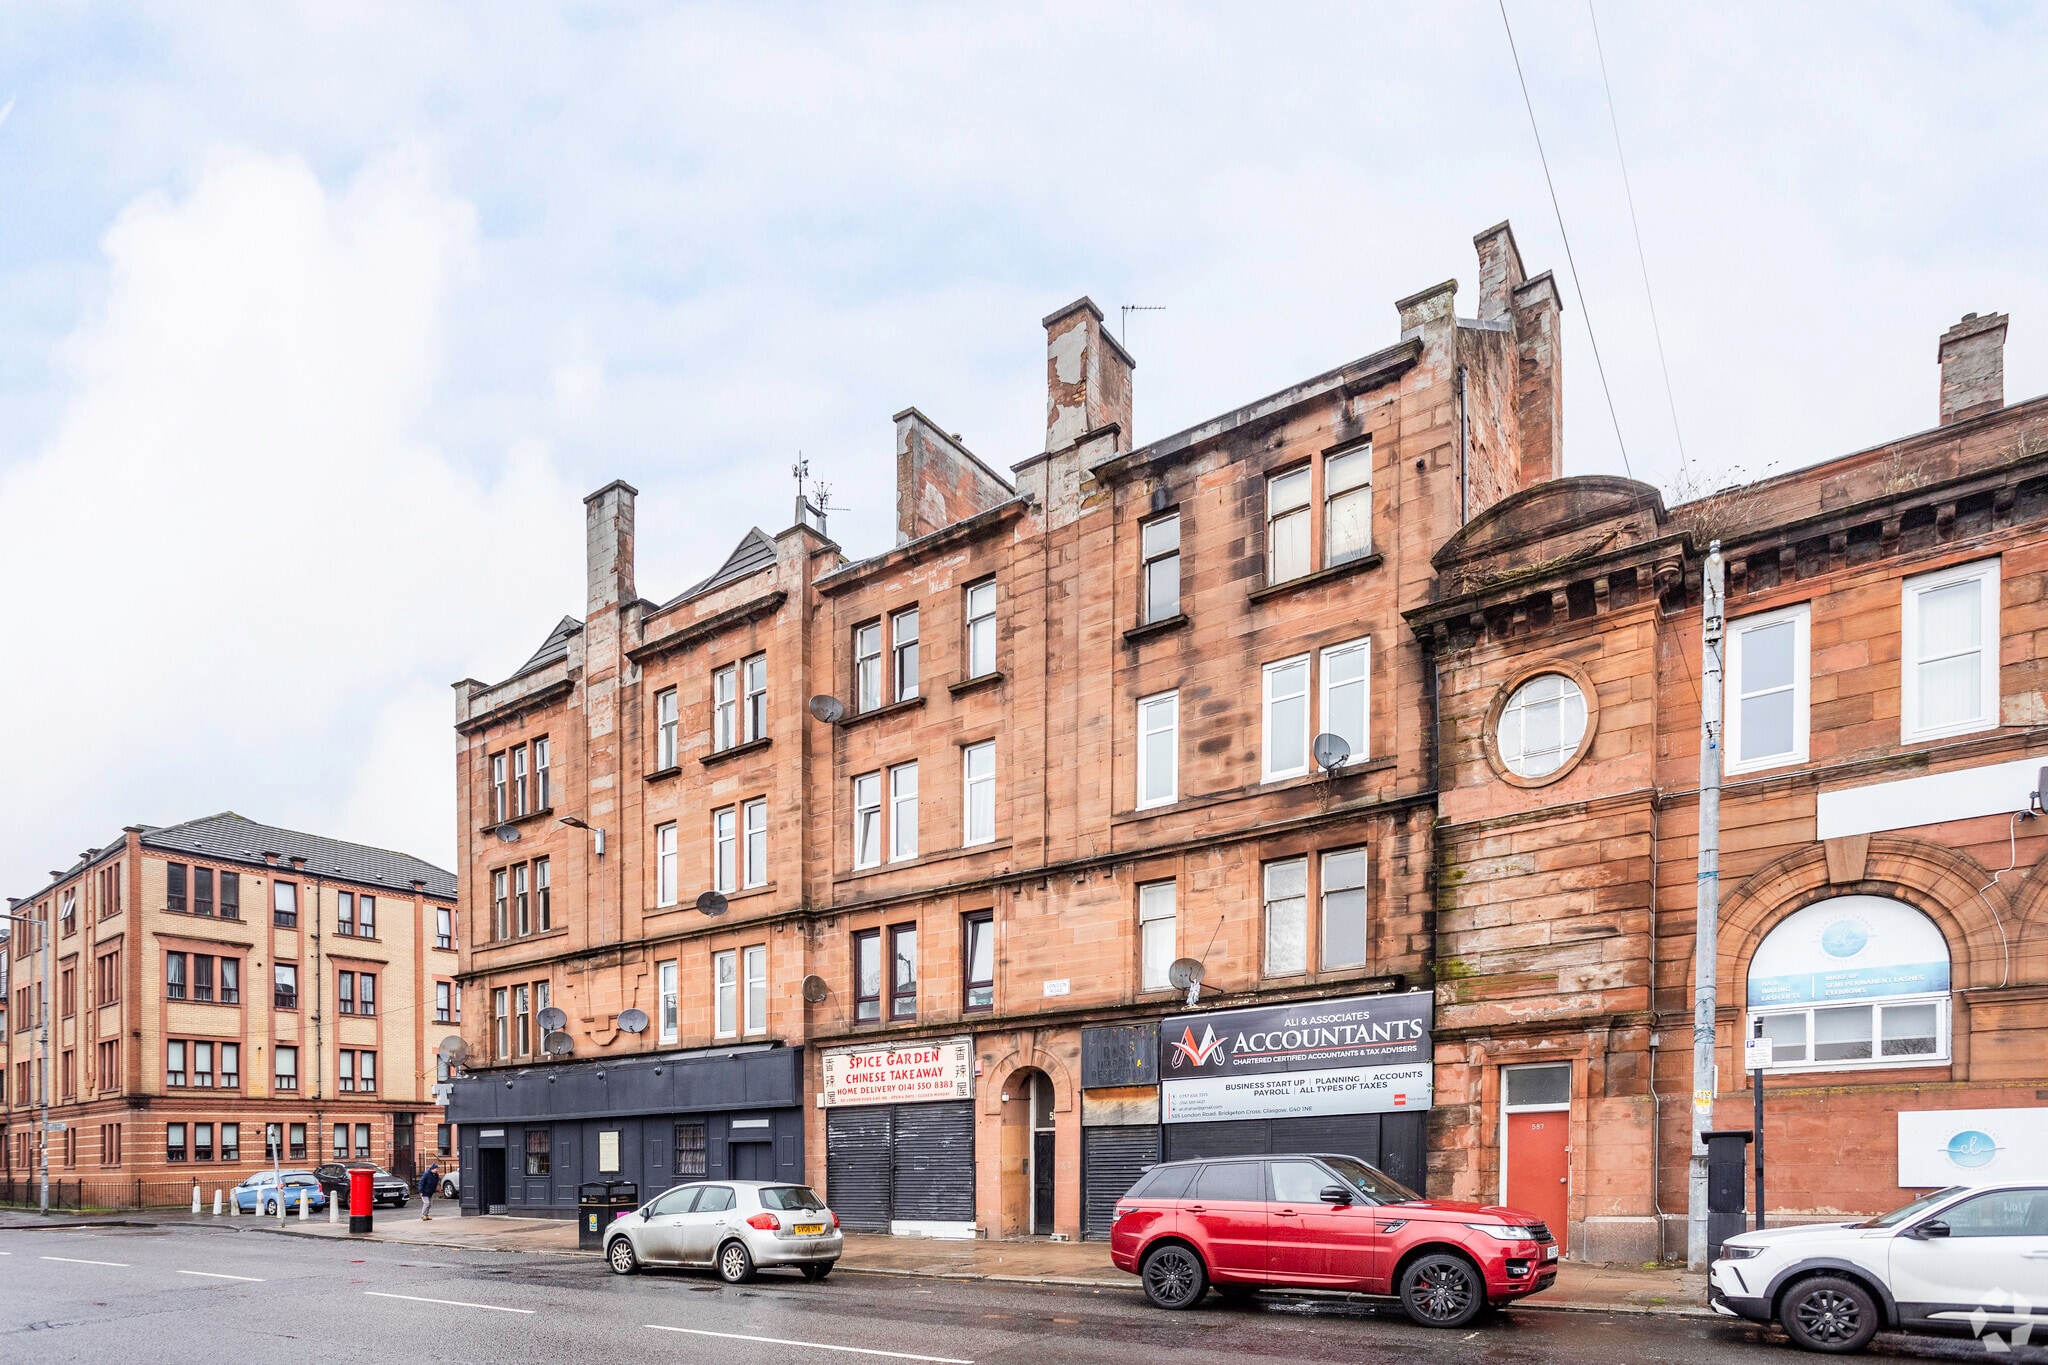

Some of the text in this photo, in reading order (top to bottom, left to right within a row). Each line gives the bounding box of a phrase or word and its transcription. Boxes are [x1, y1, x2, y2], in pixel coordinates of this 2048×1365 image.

[1845, 977, 1894, 987] PERMANENT
[1894, 974, 1925, 983] LASHES
[1825, 987, 1866, 996] EYEBROWS
[1284, 1011, 1370, 1027] ALI & ASSOCIATES
[1231, 1018, 1423, 1054] ACCOUNTANTS
[849, 1050, 939, 1069] SPICE GARDEN
[1233, 1056, 1272, 1065] CHARTERED
[1273, 1054, 1307, 1063] CERTIFIED
[1308, 1050, 1359, 1060] ACCOUNTANTS
[1366, 1047, 1380, 1055] TAX
[1380, 1045, 1418, 1055] ADVISERS
[846, 1067, 944, 1084] CHINESE TAKEAWAY
[1225, 1071, 1423, 1091] BUSINESS START UP PLANNING ACCOUNTS
[837, 1080, 954, 1096] HOME DELIVERY 0141 550 8383
[1254, 1081, 1388, 1097] PAYROLL ALL TYPES OF TAXES
[1218, 1109, 1245, 1117] Bridgeton
